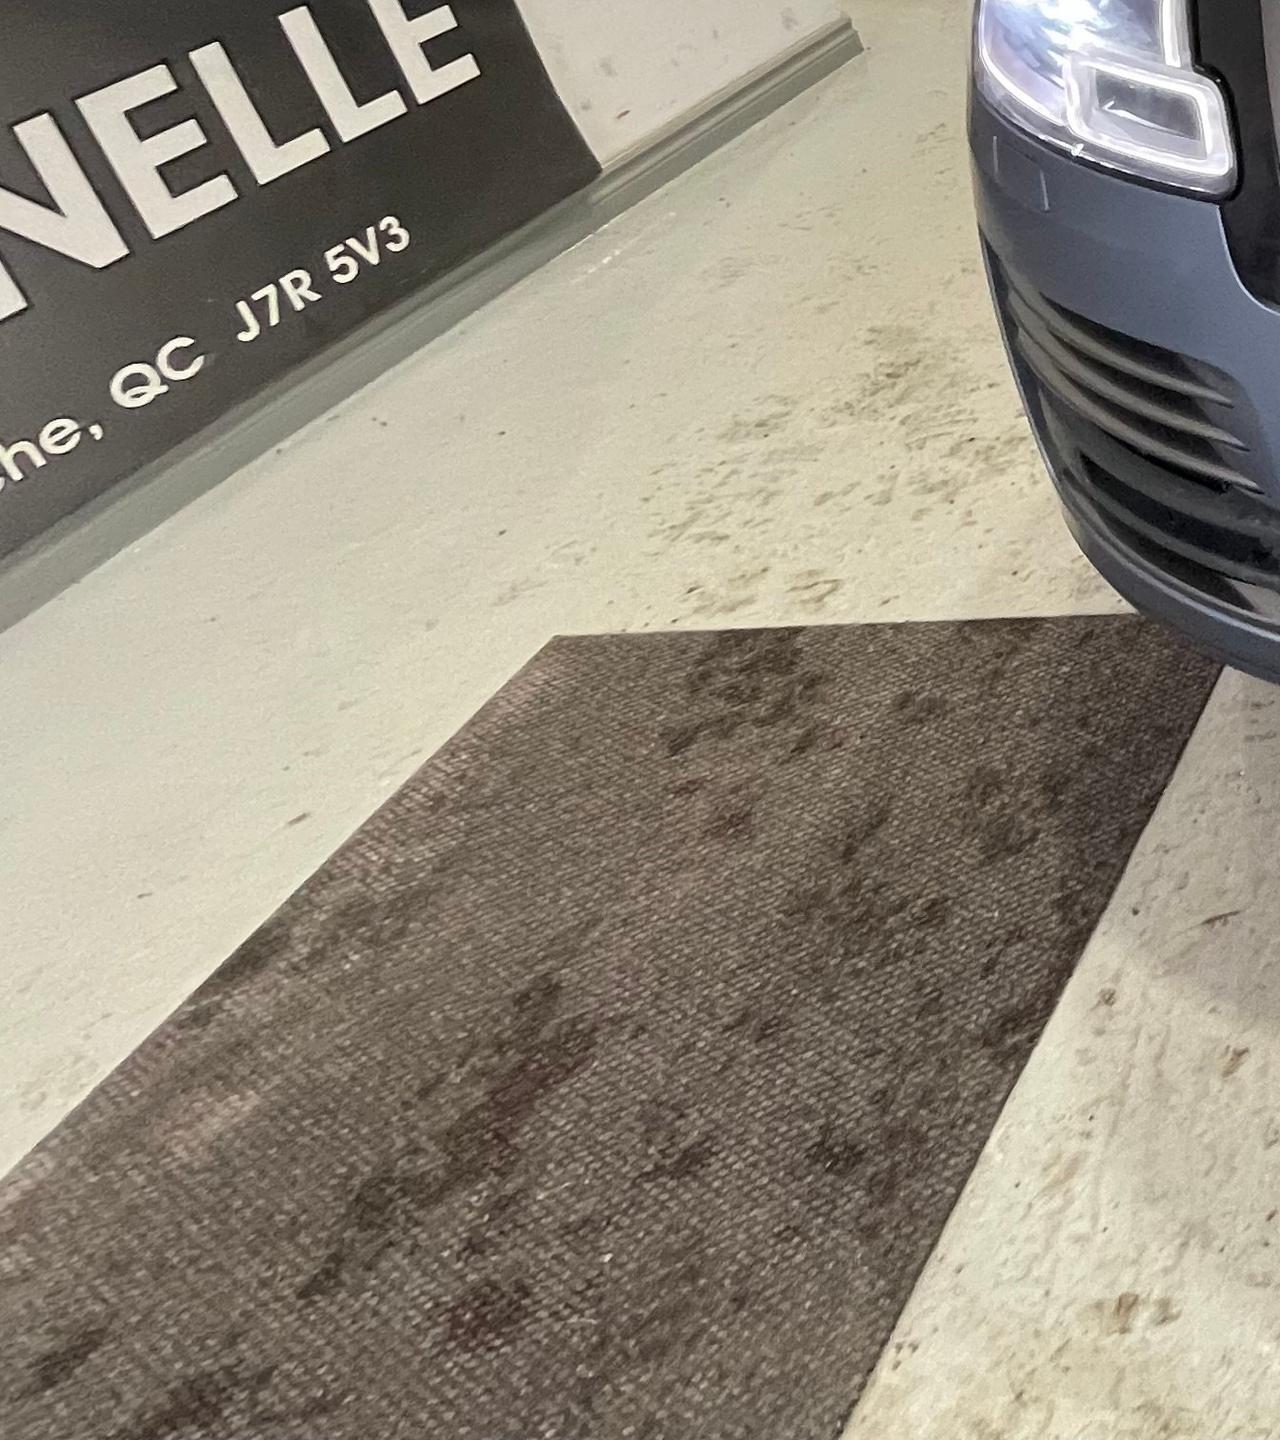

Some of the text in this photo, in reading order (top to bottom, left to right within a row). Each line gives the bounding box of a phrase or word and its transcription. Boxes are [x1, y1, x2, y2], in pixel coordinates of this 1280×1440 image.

[0, 215, 410, 492] he, QC J7R 5V3
